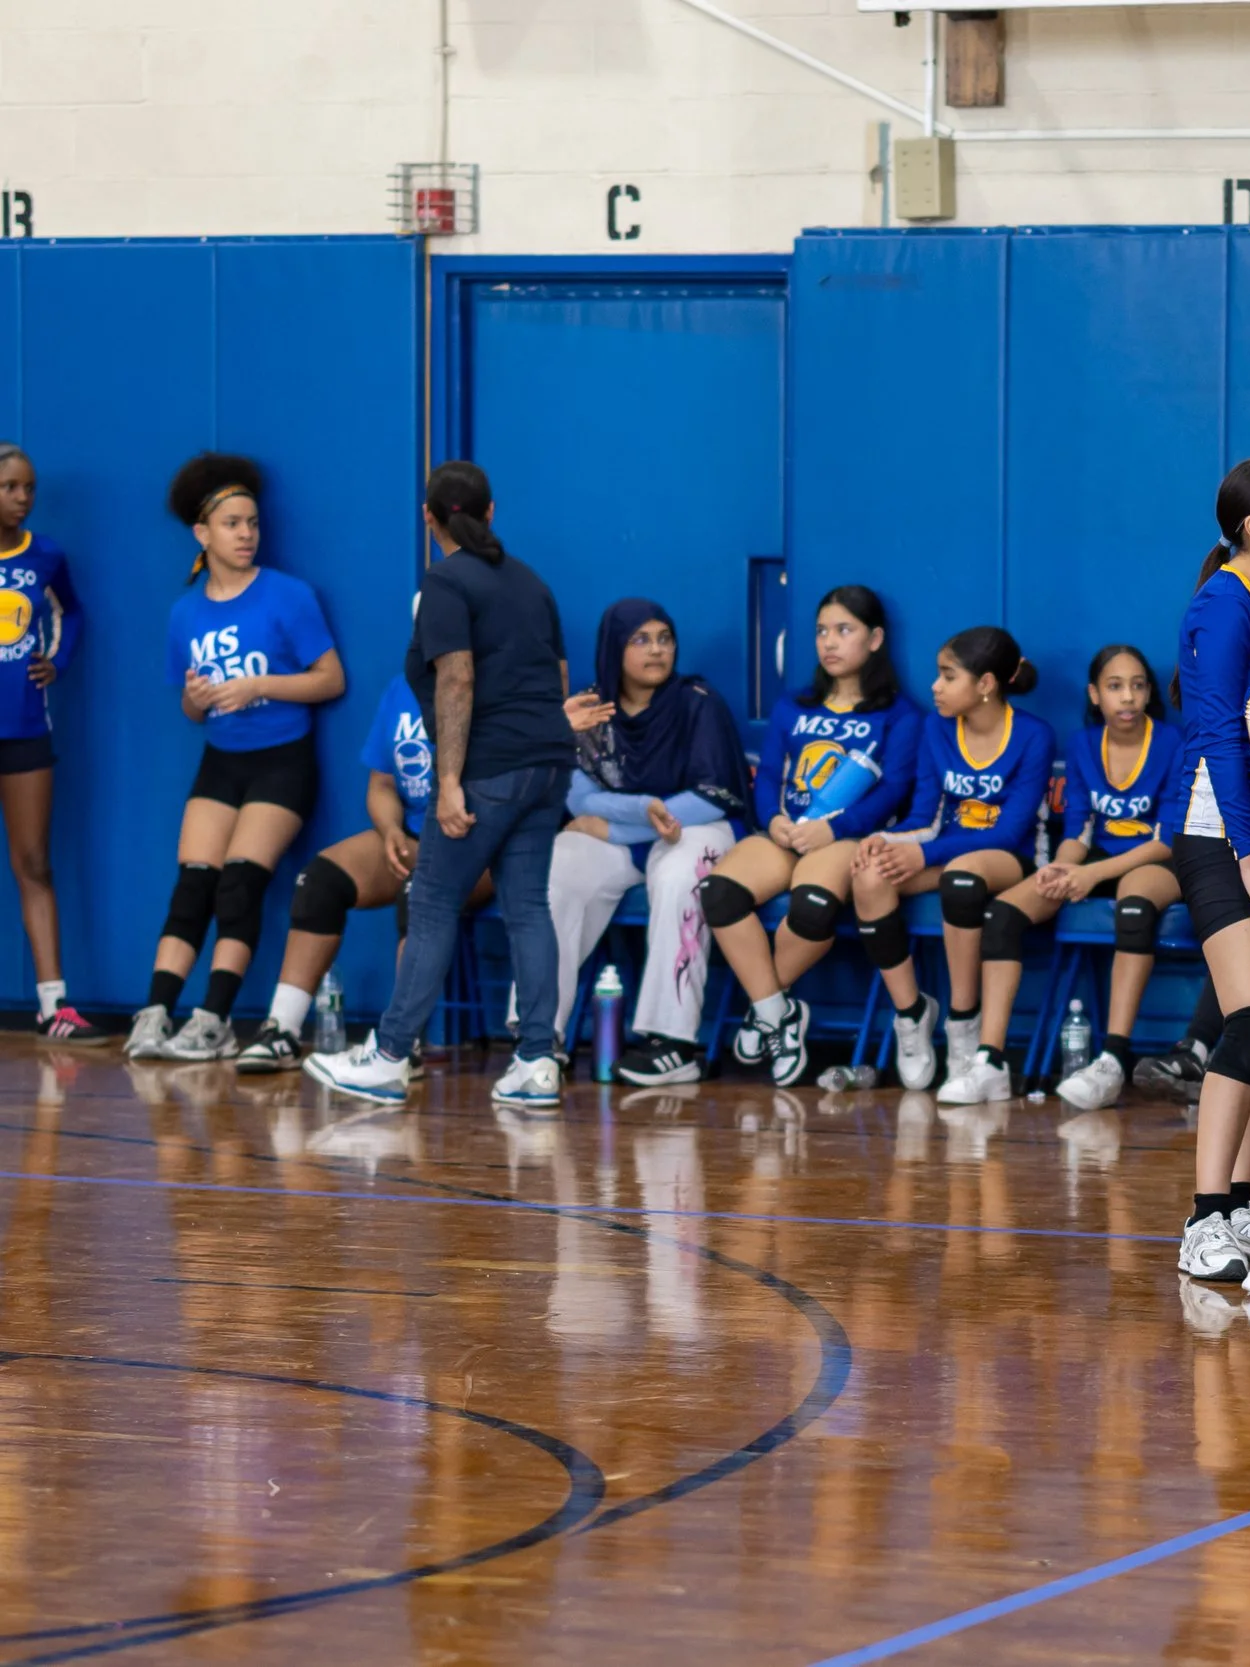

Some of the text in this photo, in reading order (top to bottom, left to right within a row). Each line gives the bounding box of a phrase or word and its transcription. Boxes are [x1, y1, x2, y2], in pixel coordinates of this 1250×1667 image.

[2, 191, 33, 238] B
[607, 184, 641, 241] C
[11, 567, 37, 590] 50
[190, 624, 239, 667] MS
[224, 650, 268, 680] 50
[394, 711, 429, 741] M
[792, 714, 871, 741] MS 50
[944, 770, 1003, 799] MS 50
[1090, 789, 1126, 817] MS
[1128, 795, 1151, 819] 50
